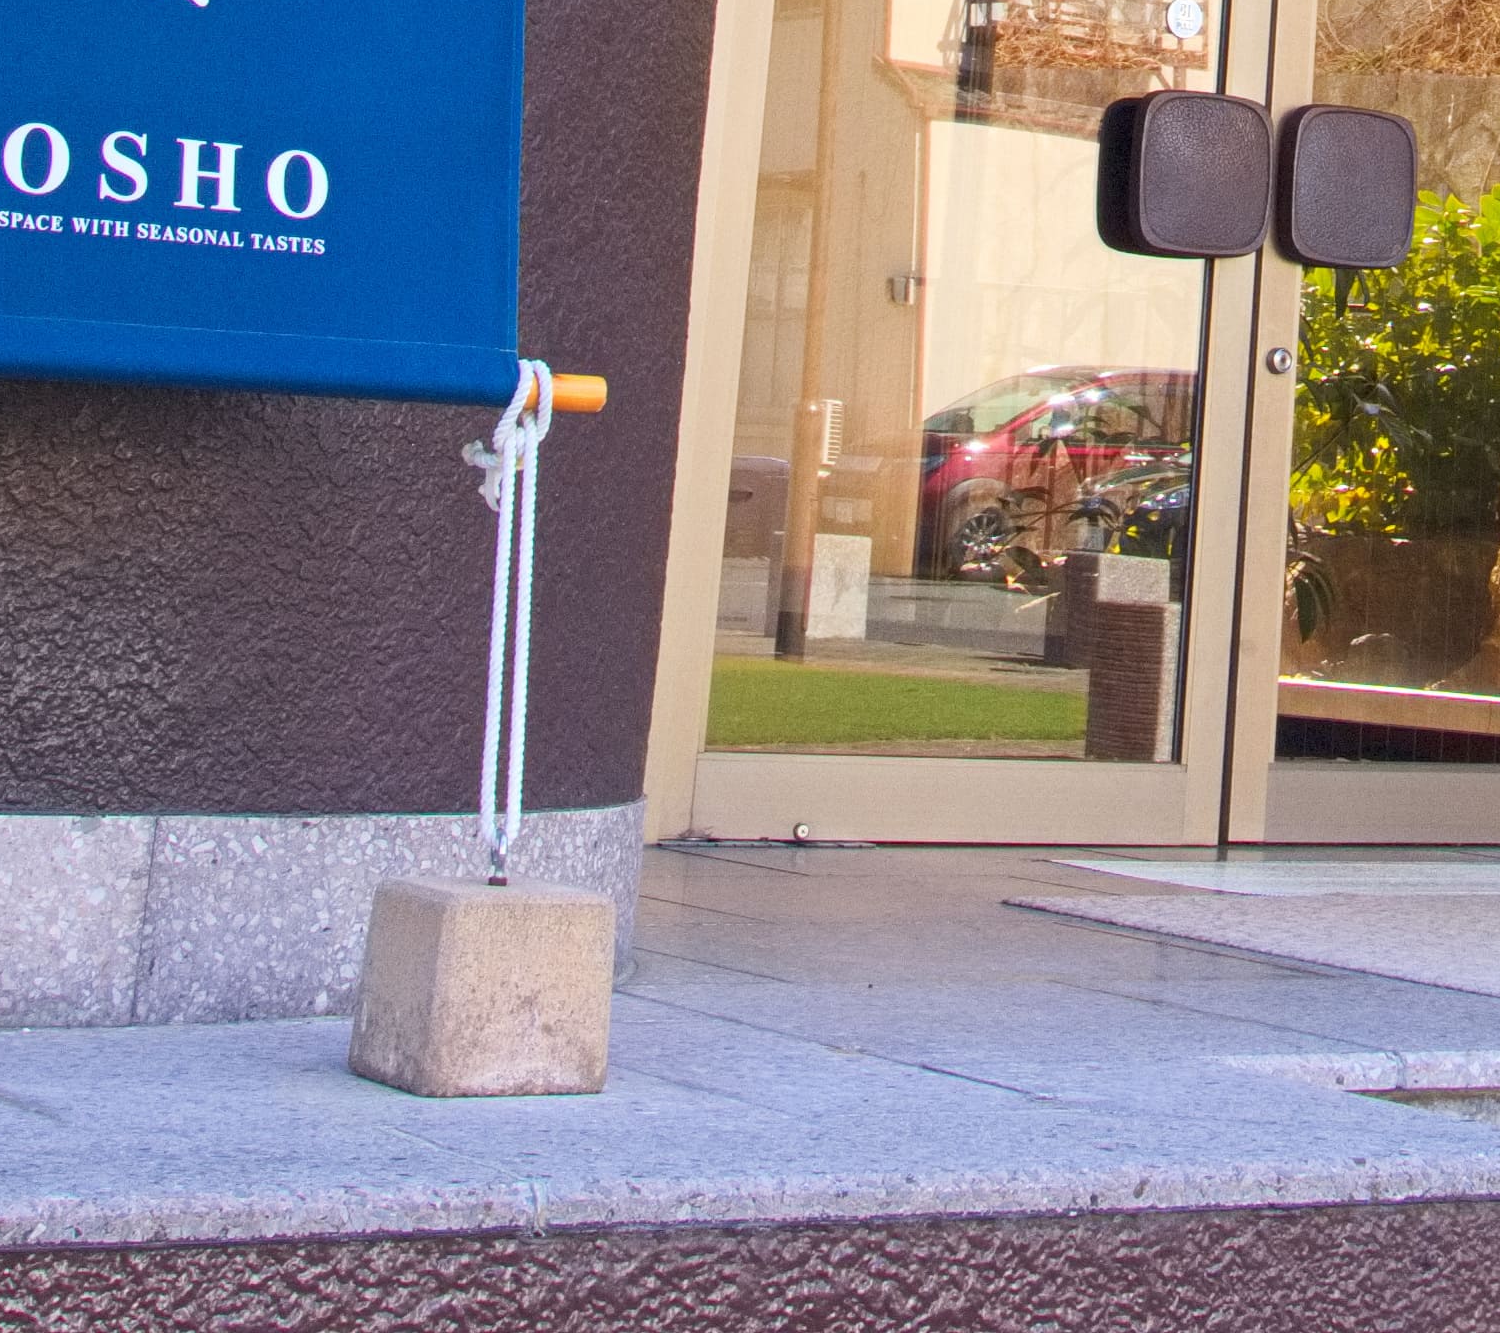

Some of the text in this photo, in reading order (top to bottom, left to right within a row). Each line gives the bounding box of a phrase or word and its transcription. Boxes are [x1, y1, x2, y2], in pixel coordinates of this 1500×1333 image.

[72, 217, 129, 237] WITH
[137, 222, 245, 247] SEASONAL
[251, 233, 326, 255] TASTES
